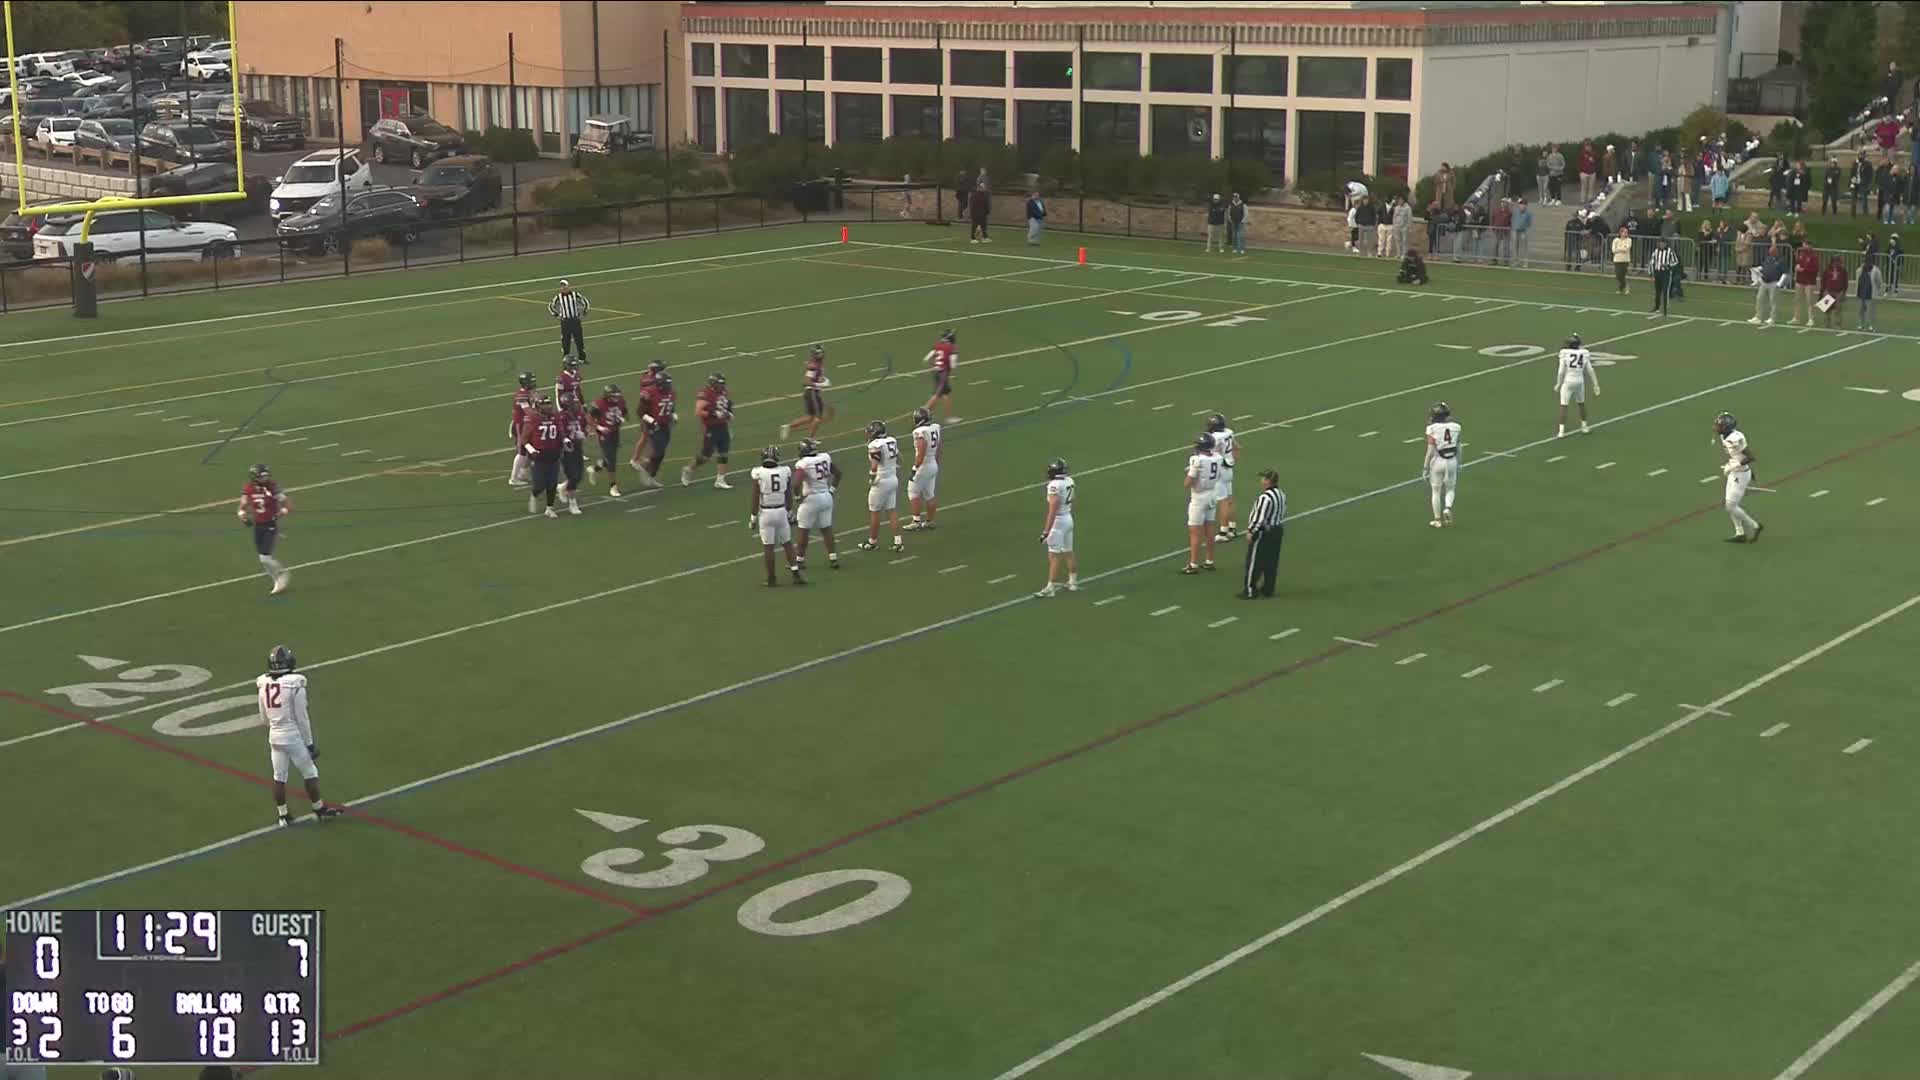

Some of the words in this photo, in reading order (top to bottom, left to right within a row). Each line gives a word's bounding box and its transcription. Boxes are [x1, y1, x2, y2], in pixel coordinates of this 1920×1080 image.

[1569, 354, 1584, 368] 24
[539, 424, 557, 440] 70
[1444, 429, 1452, 444] 4
[1209, 462, 1218, 480] 9
[771, 474, 780, 492] 6
[266, 683, 281, 708] 12
[580, 824, 912, 936] 30
